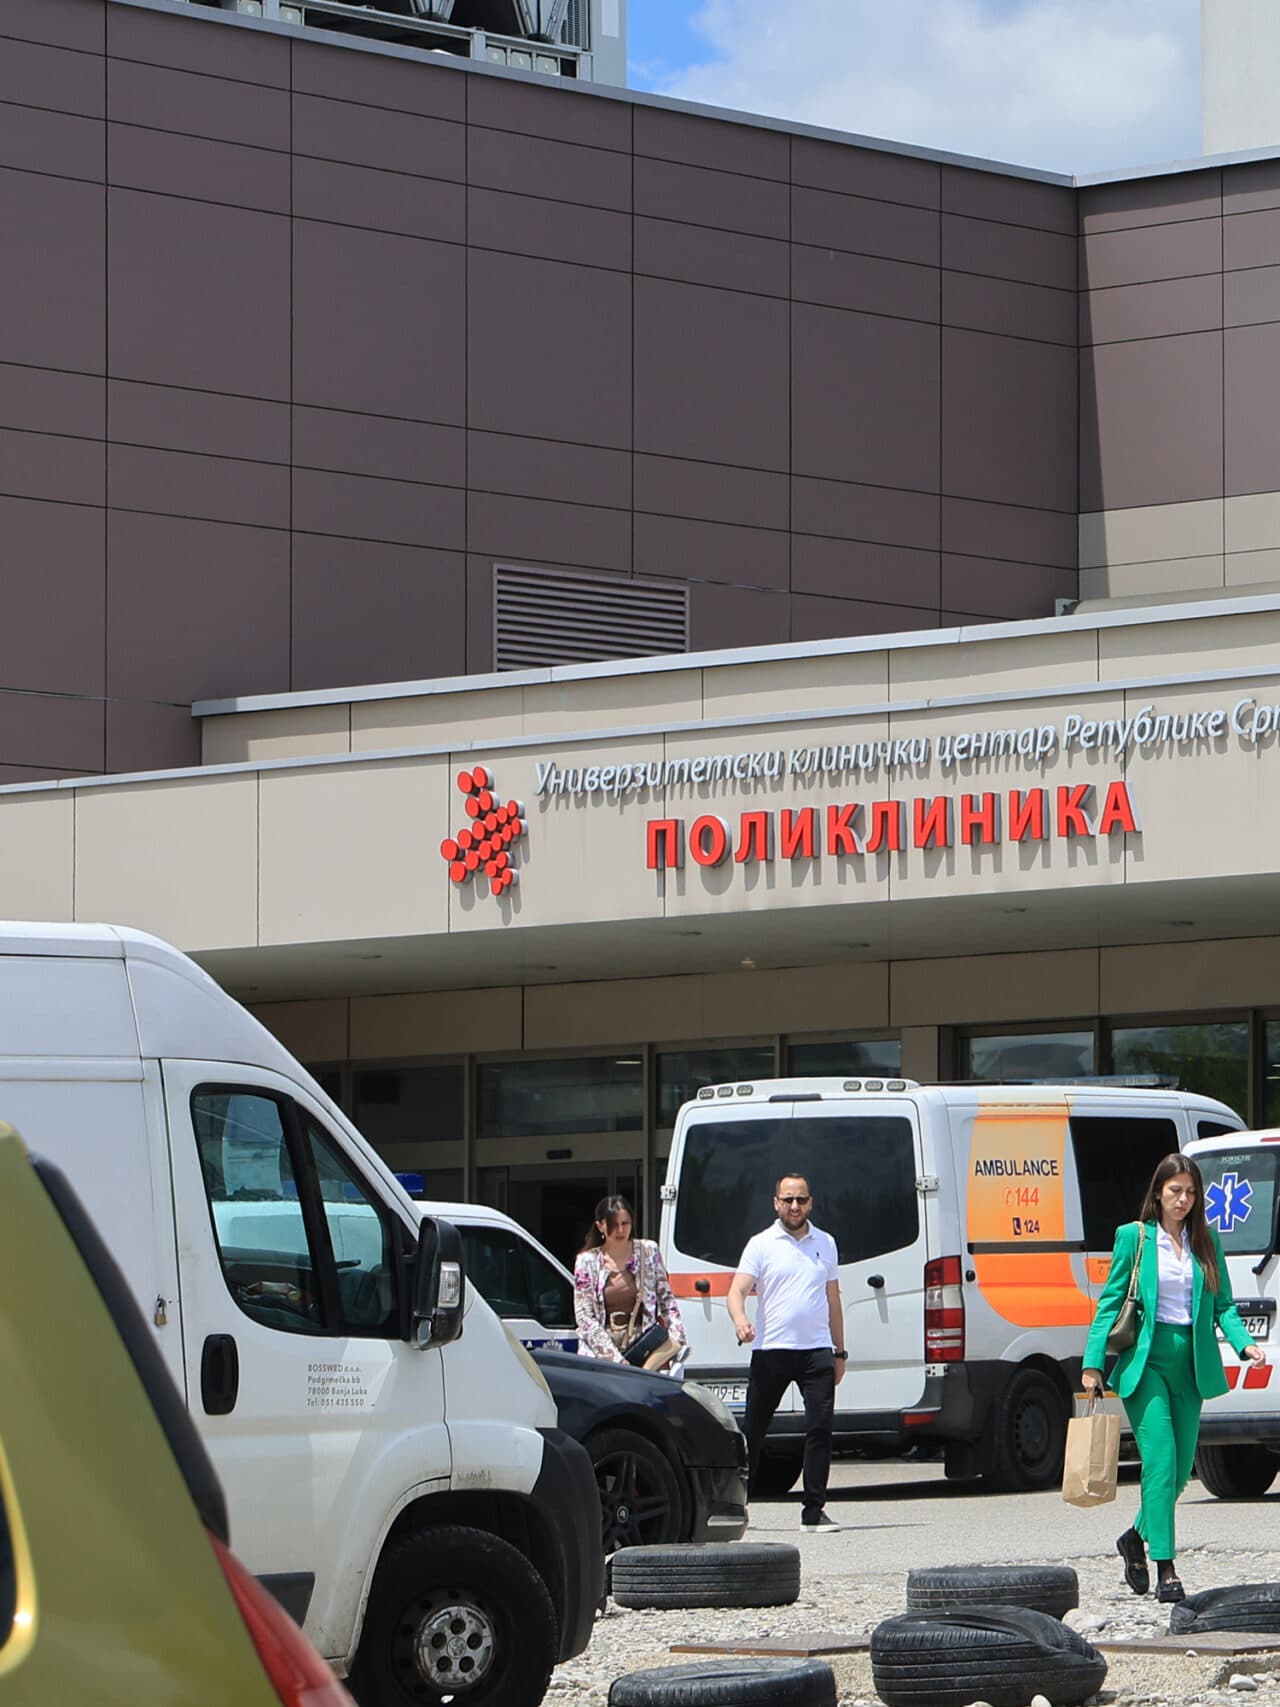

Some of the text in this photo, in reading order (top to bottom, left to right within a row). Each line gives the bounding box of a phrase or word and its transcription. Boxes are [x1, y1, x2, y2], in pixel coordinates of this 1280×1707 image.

[535, 751, 784, 798] Универзитетски
[789, 735, 930, 775] клинички
[936, 724, 1057, 767] центар
[1064, 705, 1227, 756] Републике
[647, 781, 1142, 869] ПОЛИКЛИНИКА
[975, 1160, 1059, 1176] AMBULANCE
[1015, 1186, 1040, 1206] 144
[1023, 1219, 1040, 1233] 124
[307, 1364, 343, 1372] BOSSWED
[351, 1375, 361, 1384] bb
[307, 1386, 367, 1397] 78000 Banja Luka
